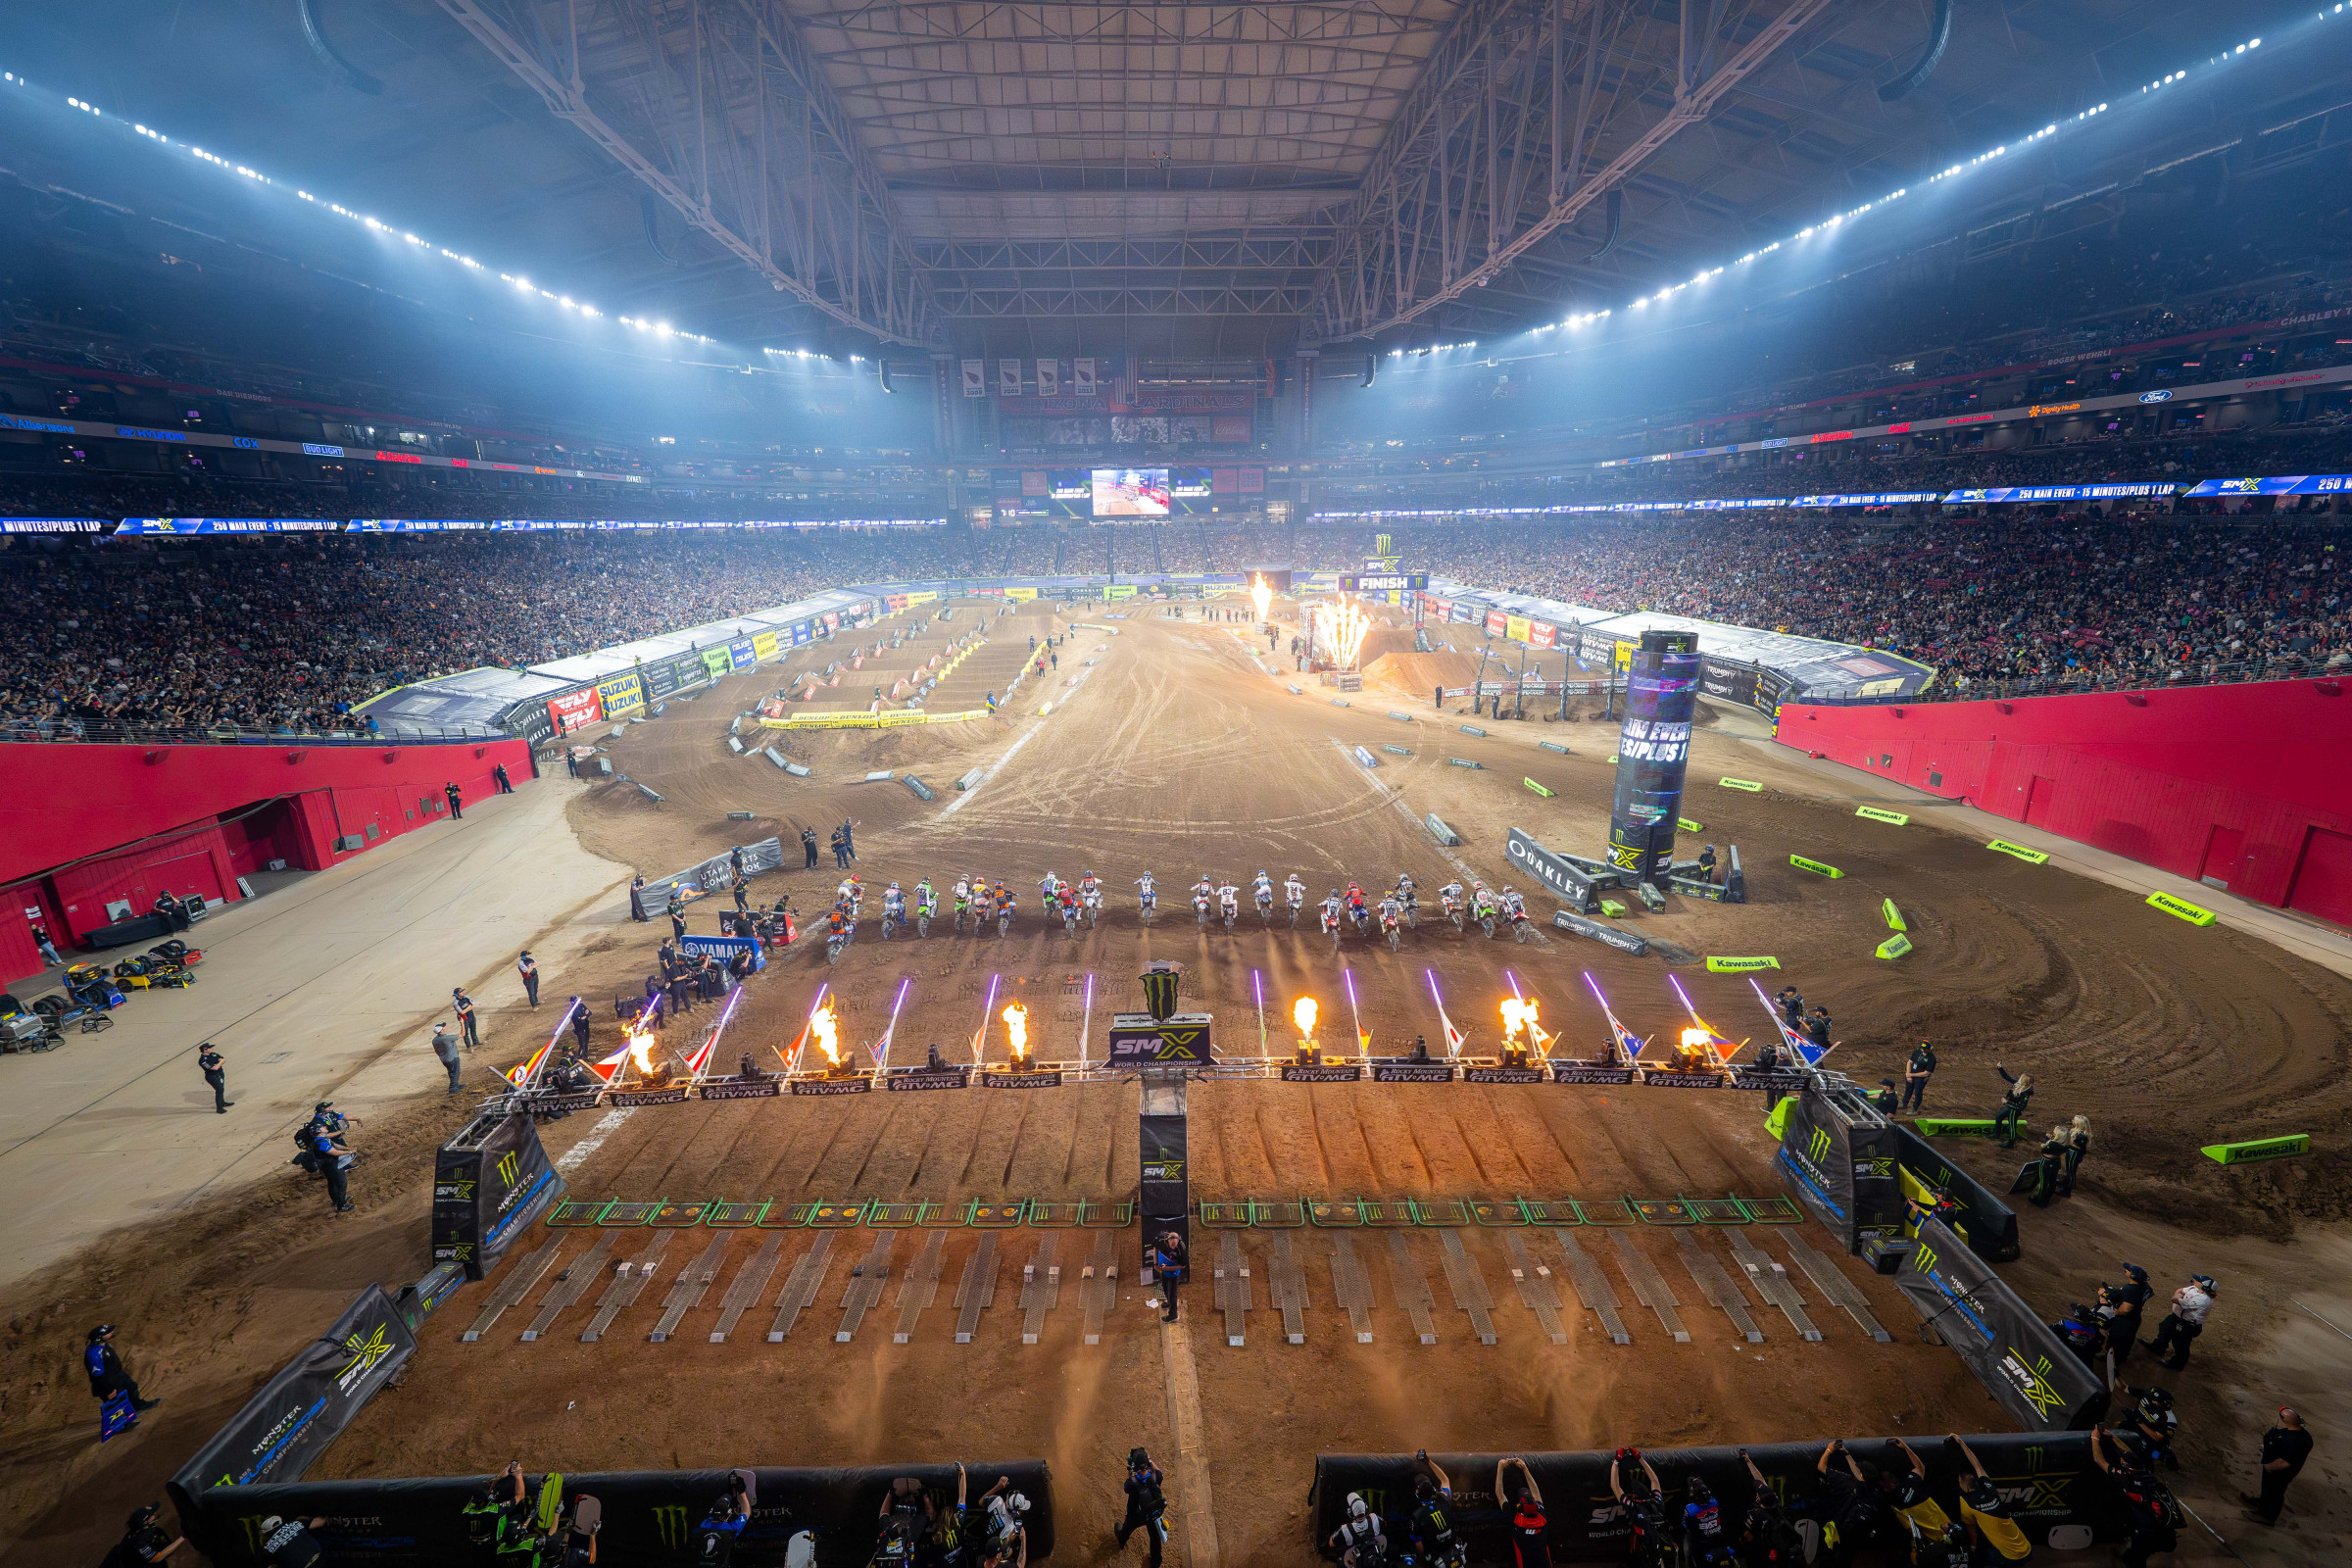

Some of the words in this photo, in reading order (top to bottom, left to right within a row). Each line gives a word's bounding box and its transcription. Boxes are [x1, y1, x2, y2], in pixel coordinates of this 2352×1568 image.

[2280, 309, 2341, 326] CHARLEY
[2047, 355, 2076, 366] ROGER
[2078, 349, 2111, 362] WEHRLI
[2144, 392, 2167, 402] Ford
[2042, 406, 2060, 416] Dignity
[2062, 403, 2080, 412] Health
[233, 437, 260, 449] COX
[321, 446, 343, 455] LIGHT
[2019, 490, 2033, 499] 250
[2034, 489, 2052, 499] MAIN
[2054, 488, 2076, 498] EVENT
[2082, 488, 2090, 497] 15
[2092, 486, 2150, 497] MINUTES/PLUS
[2152, 485, 2156, 495] 1
[2158, 484, 2175, 495] LAP
[2221, 478, 2262, 492] SMX
[1839, 495, 1848, 504] 250
[1862, 495, 1876, 504] EVENT
[1963, 489, 1987, 499] SMX
[4, 521, 76, 532] MINUTES/PLUS
[78, 521, 82, 531] 1
[83, 521, 102, 531] LAP
[142, 518, 175, 530] SMX
[281, 521, 321, 530] MINUTES/PLUS
[327, 521, 337, 530] LAP
[1366, 559, 1399, 572] SMX
[1358, 577, 1408, 589] FINISH
[1707, 665, 1730, 678] TRIUMPH
[599, 677, 638, 698] SUZUKI
[1705, 682, 1727, 694] TRIUMPH
[554, 690, 592, 708] FLY
[1724, 779, 1757, 789] Kawasaki
[1862, 808, 1901, 820] Kawasaki
[1995, 841, 2040, 859] Kawasaki
[700, 865, 722, 880] UTAH
[727, 854, 758, 870] SRTS
[704, 862, 760, 888] COMMIION
[1794, 858, 1832, 876] Kawasaki
[1527, 853, 1585, 900] OAKLEY
[2155, 896, 2203, 919] Kawasaki
[1557, 917, 1586, 934] TRIUMPH
[1599, 932, 1631, 951] TRIUMPH
[700, 943, 749, 958] YAMAH
[1716, 959, 1772, 968] Kawasaki
[1113, 1031, 1200, 1059] SMX
[2233, 1141, 2301, 1160] Kawasaki
[1144, 1164, 1183, 1179] SMX
[1795, 1149, 1831, 1188] MONSTER
[1855, 1161, 1891, 1175] SMX
[435, 1184, 473, 1199] SMX
[498, 1172, 534, 1212] MONSTER
[1780, 1149, 1844, 1219] SUPERCROSS
[486, 1170, 552, 1246] SUPERCROSS
[503, 1192, 543, 1237] CHAMPIONSHIP
[435, 1247, 472, 1260] SMX
[1950, 1274, 1984, 1314] MONSTER
[1936, 1290, 1976, 1331] CHAMPIONSHIP
[339, 1328, 391, 1392] SMX
[345, 1379, 361, 1398] WORLD
[360, 1343, 397, 1382] CHAMPIONSHIP
[1996, 1365, 2014, 1386] WORLD
[2013, 1383, 2049, 1423] CHAMPIONSHIP
[2001, 1355, 2060, 1417] SMX
[252, 1404, 302, 1456] MONSTER
[240, 1395, 326, 1486] SUPERCROSS
[264, 1420, 314, 1474] CHAMPIONSHIP
[1588, 1529, 1614, 1539] WORLD
